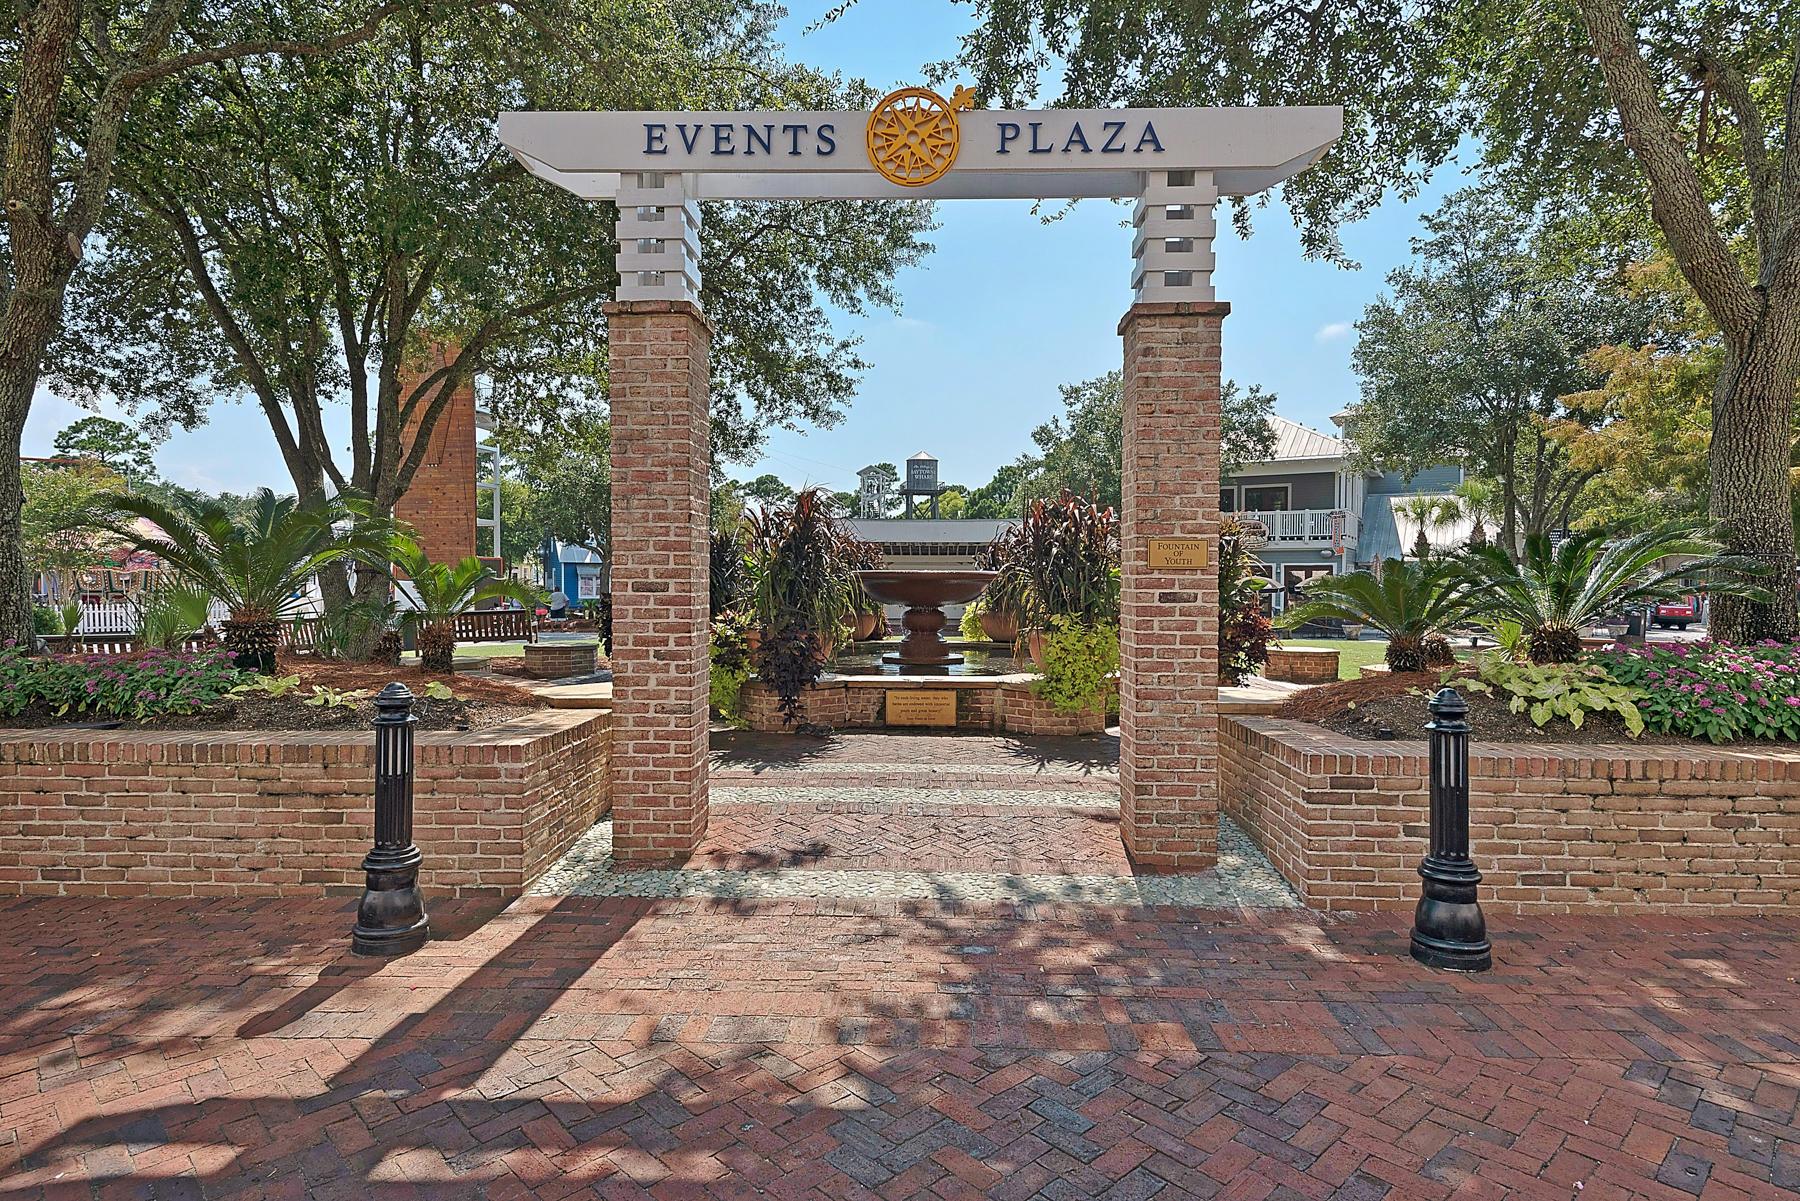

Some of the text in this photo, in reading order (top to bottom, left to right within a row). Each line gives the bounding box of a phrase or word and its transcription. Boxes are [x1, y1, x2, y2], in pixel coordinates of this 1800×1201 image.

[643, 120, 1166, 156] EVENTS PLAZA
[1165, 557, 1193, 565] YOUTH
